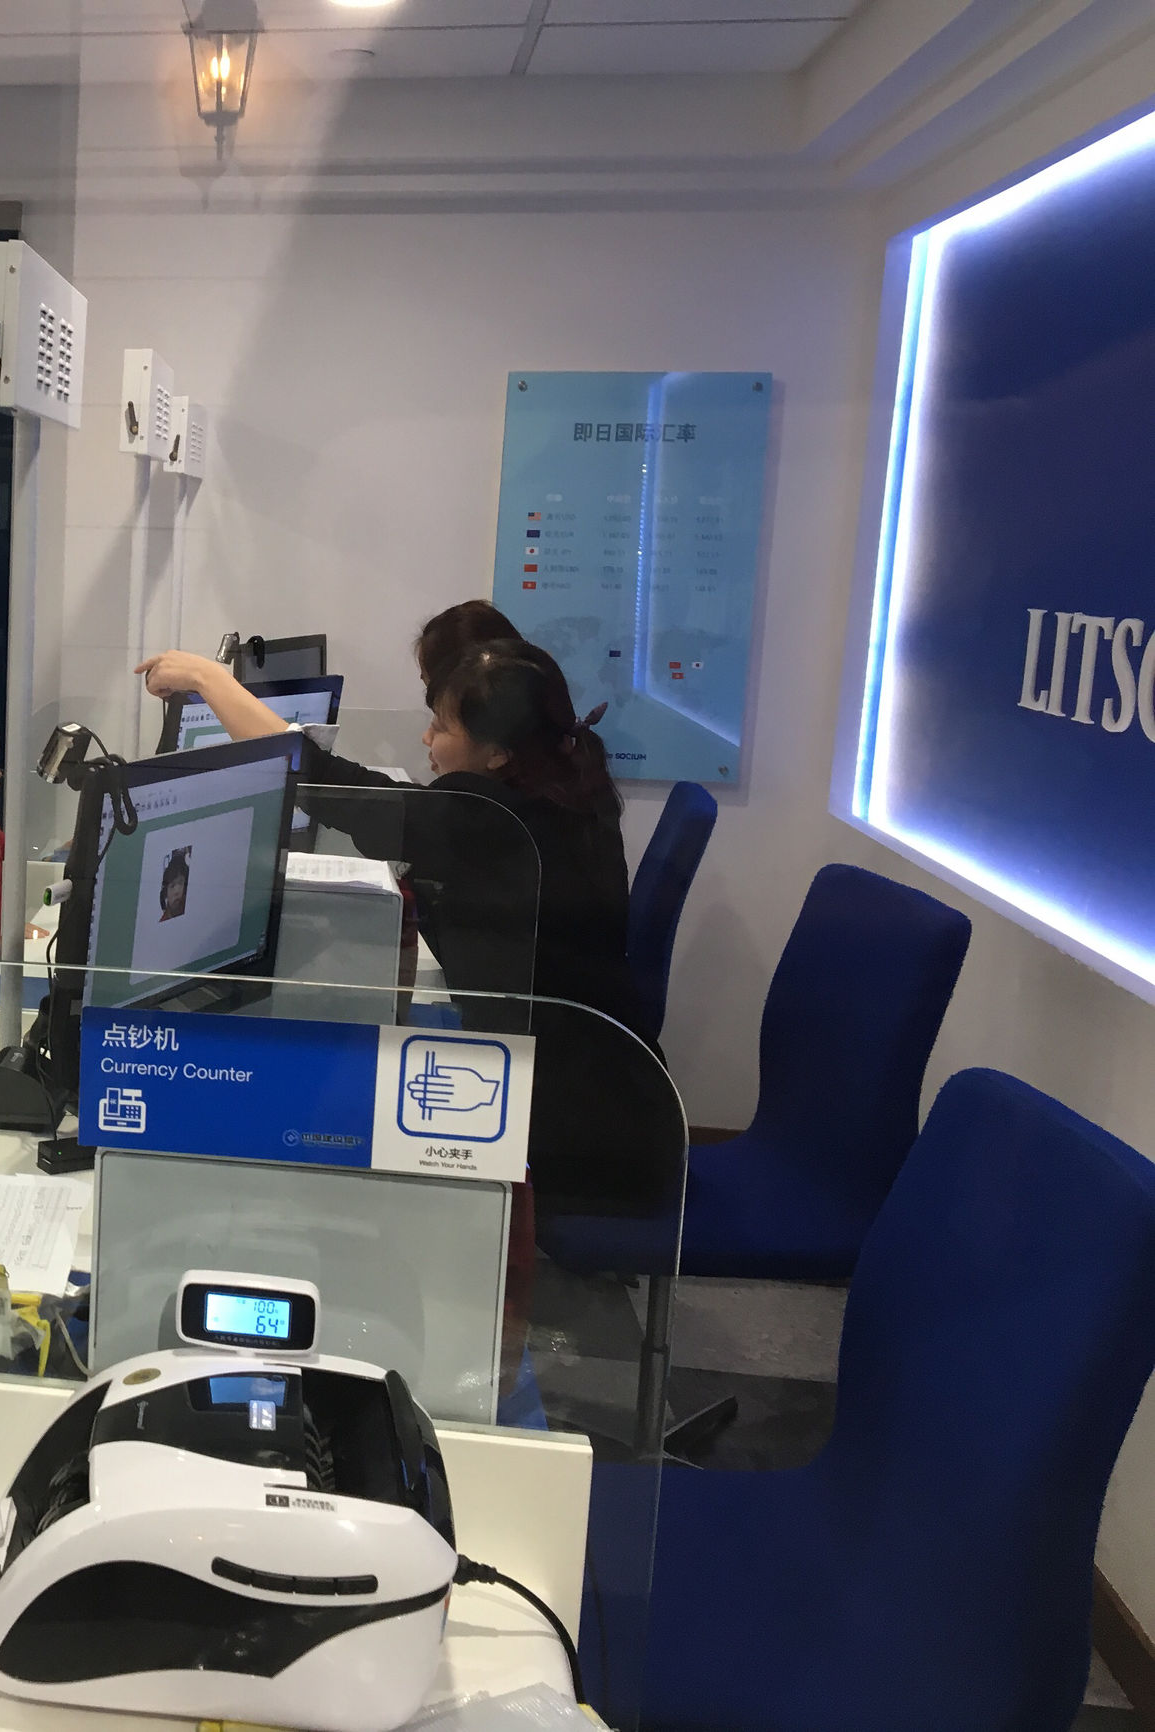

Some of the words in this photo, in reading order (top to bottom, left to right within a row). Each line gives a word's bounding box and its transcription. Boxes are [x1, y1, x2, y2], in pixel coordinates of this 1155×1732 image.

[573, 422, 698, 443] 即日国际汇率
[101, 1023, 179, 1052] 点钞机
[100, 1057, 177, 1081] Currency
[183, 1063, 253, 1083] Counter
[425, 1145, 474, 1160] 小心夹手
[255, 1315, 279, 1334] 64
